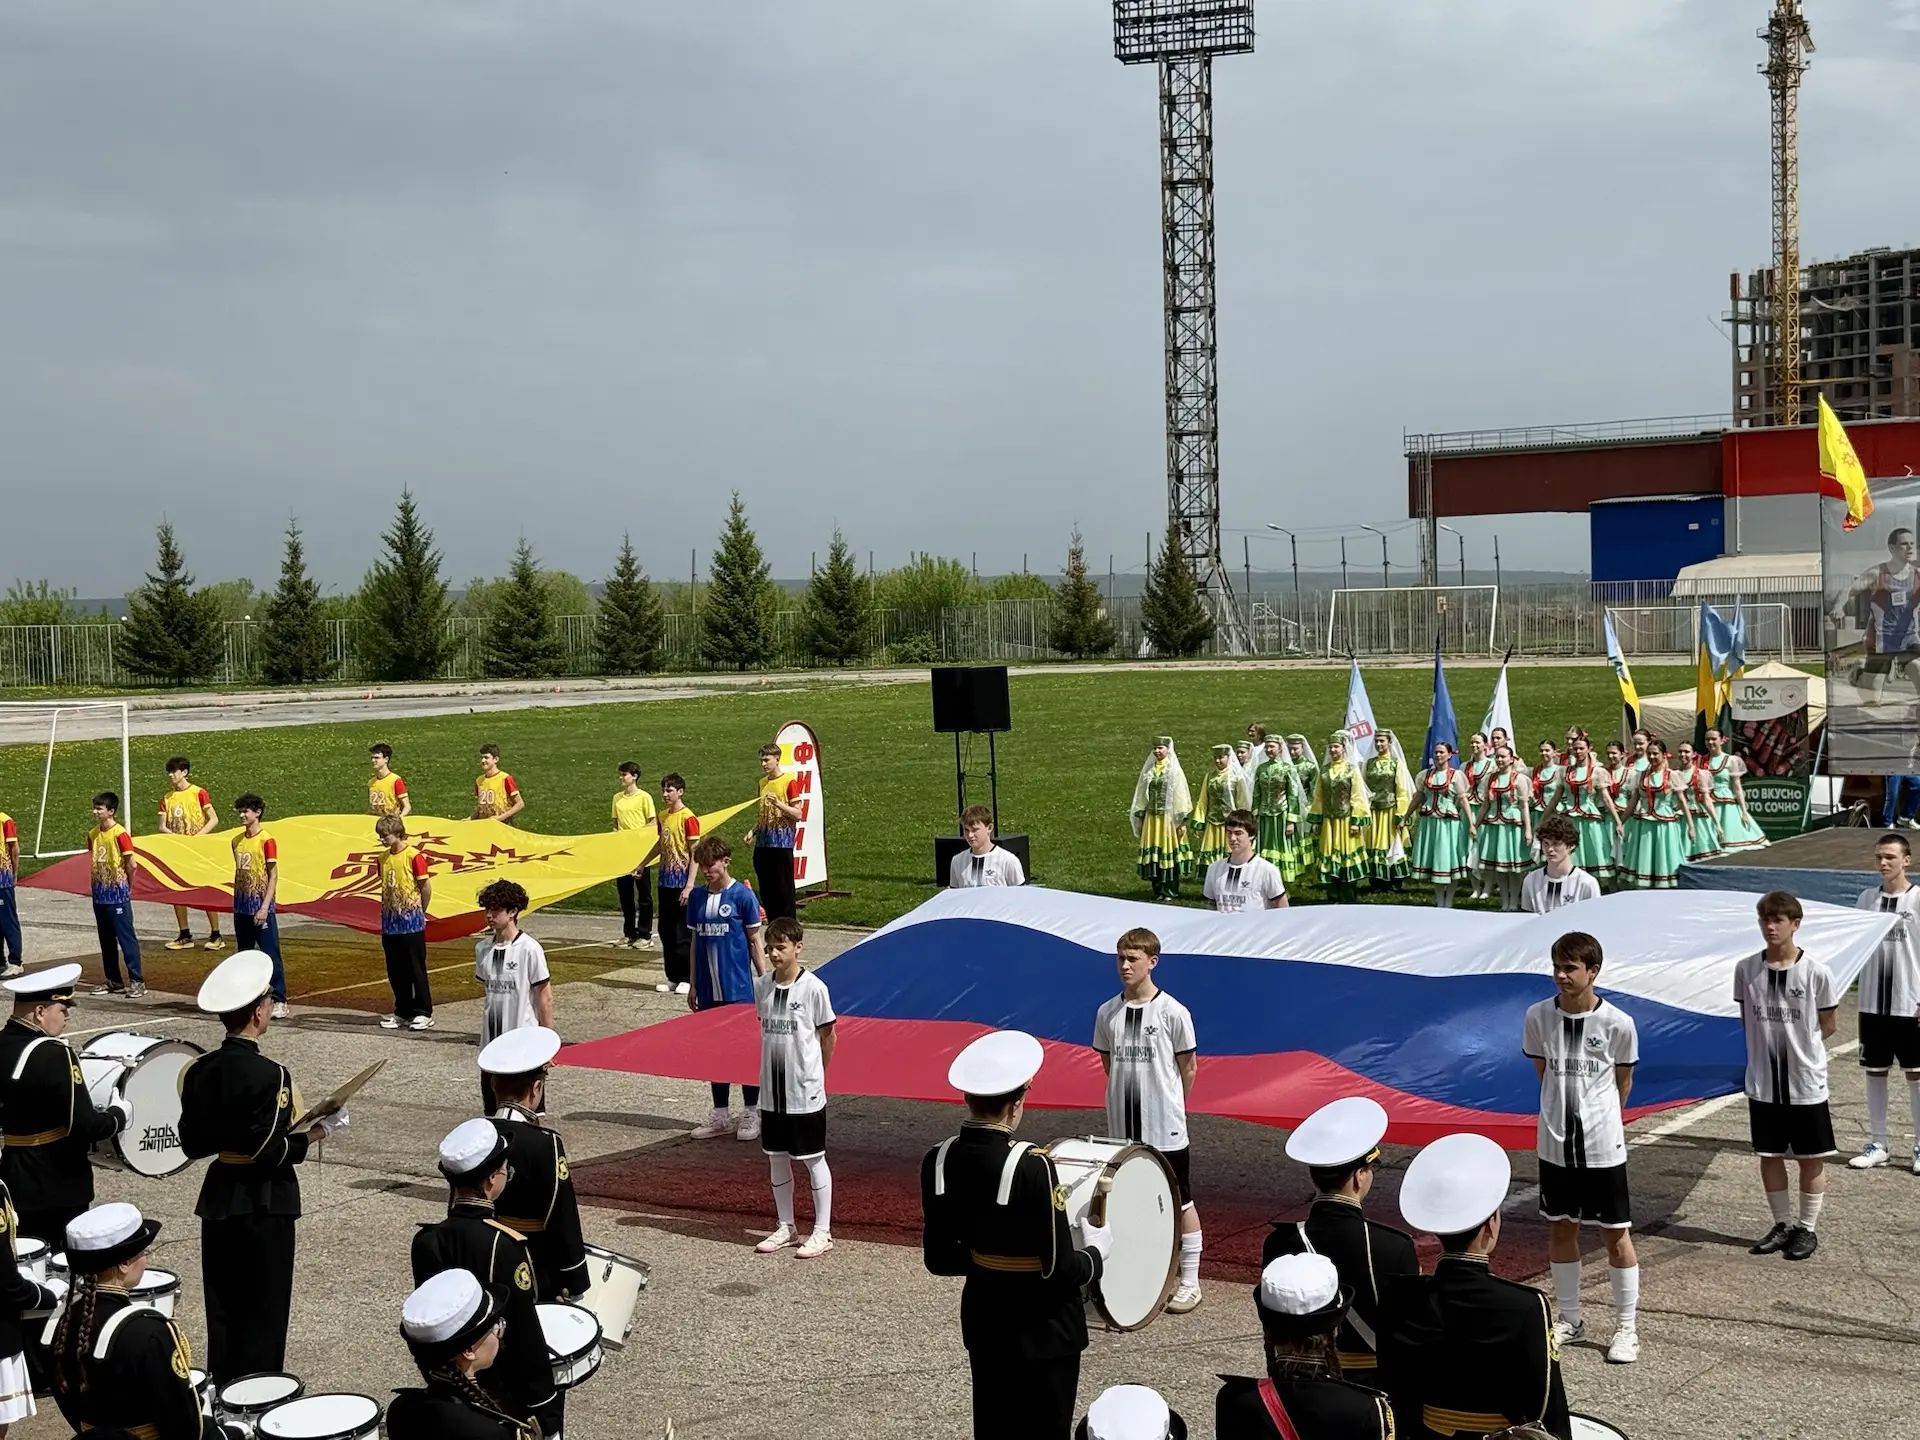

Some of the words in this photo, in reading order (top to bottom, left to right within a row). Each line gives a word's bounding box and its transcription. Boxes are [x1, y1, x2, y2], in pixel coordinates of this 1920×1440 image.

[372, 792, 385, 806] 22
[480, 789, 495, 805] 20
[1761, 788, 1802, 800] ВКУСНО
[1764, 802, 1800, 813] СОЧНО
[97, 846, 106, 863] 2
[237, 852, 252, 870] 12
[388, 870, 396, 888] 3
